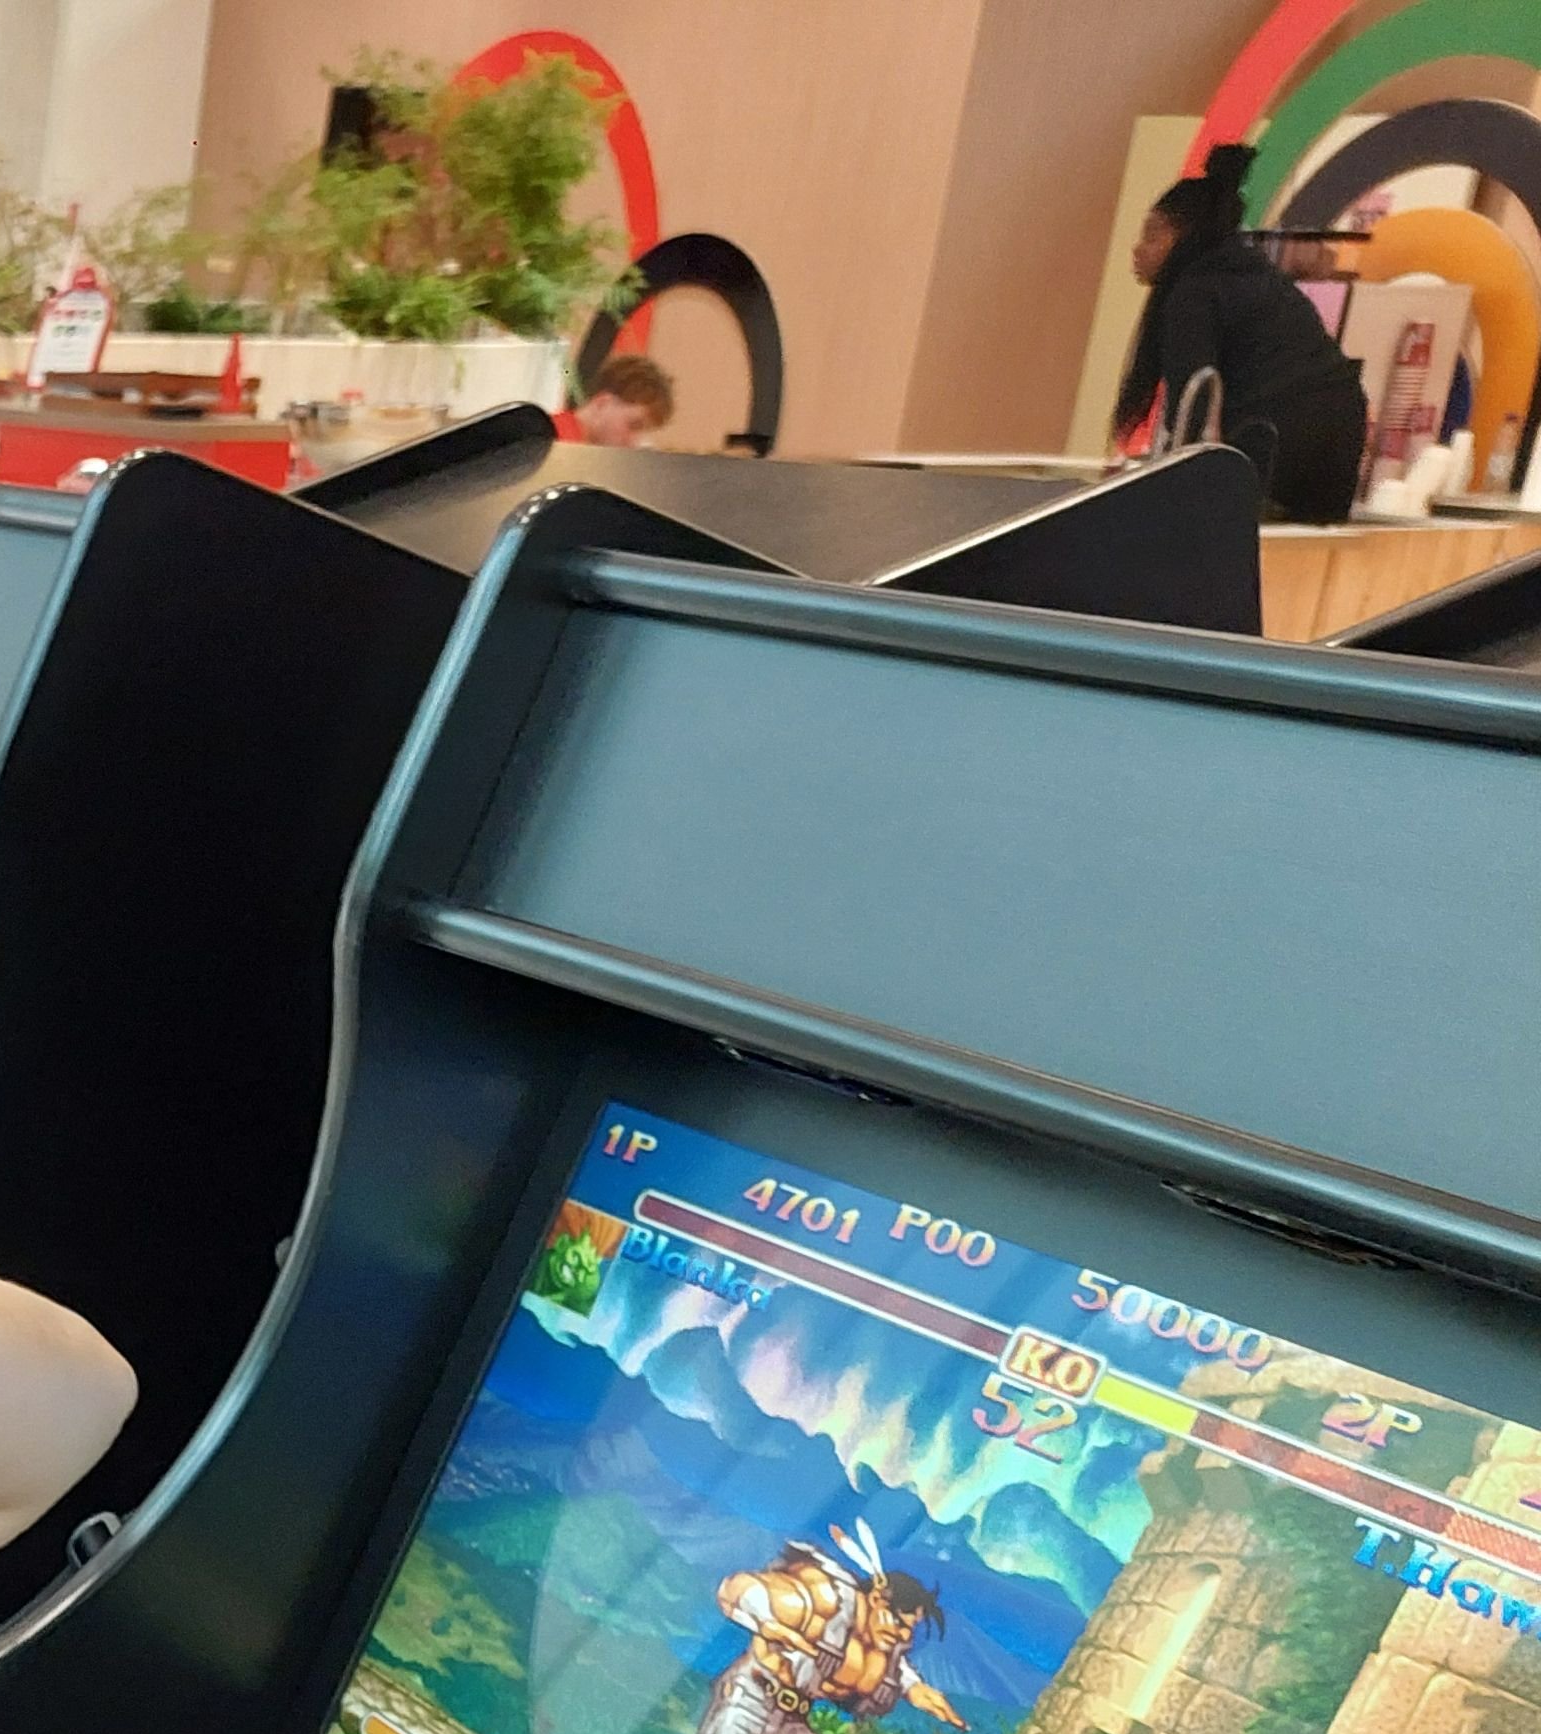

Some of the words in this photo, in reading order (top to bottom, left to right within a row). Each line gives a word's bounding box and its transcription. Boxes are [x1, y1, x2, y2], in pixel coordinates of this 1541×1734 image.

[601, 1123, 659, 1165] 1P
[743, 1177, 862, 1245] 4701
[621, 1228, 773, 1311] Blanka
[1071, 1268, 1274, 1373] 50000
[972, 1370, 1080, 1465] 52
[1320, 1391, 1424, 1450] 2P
